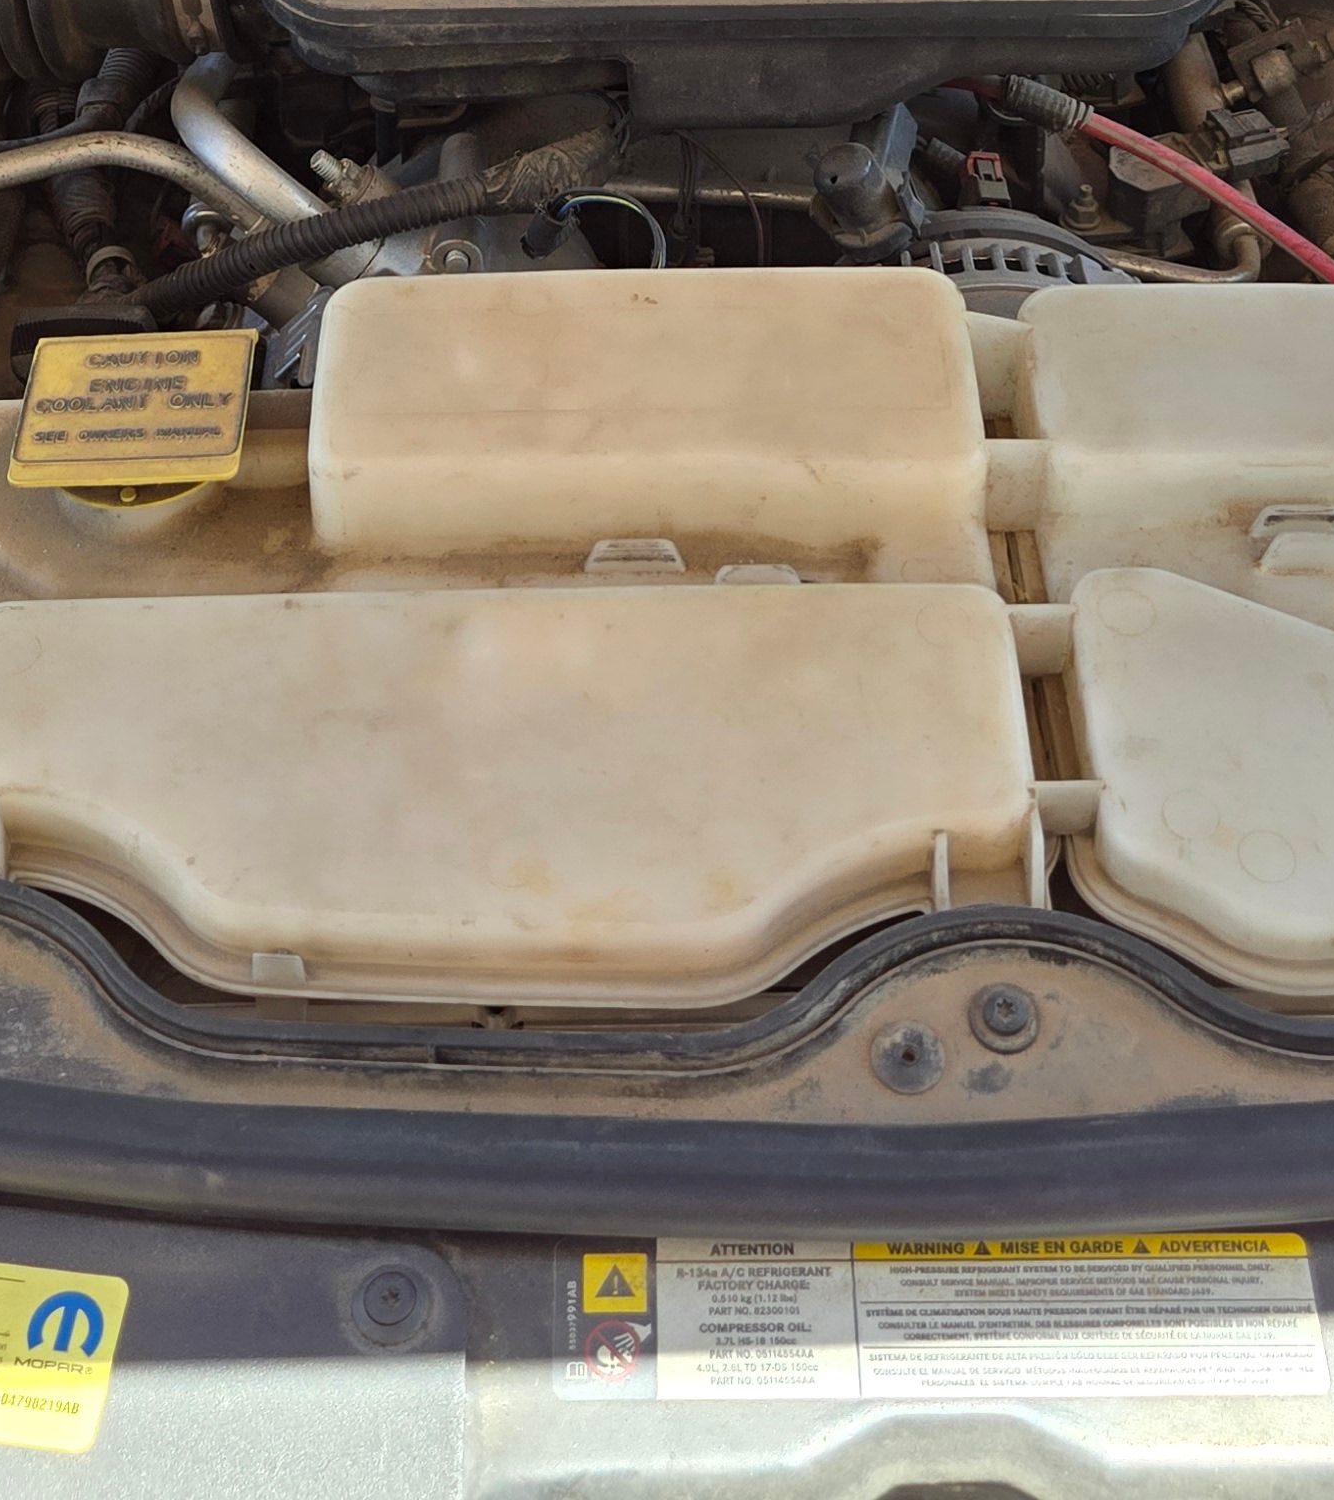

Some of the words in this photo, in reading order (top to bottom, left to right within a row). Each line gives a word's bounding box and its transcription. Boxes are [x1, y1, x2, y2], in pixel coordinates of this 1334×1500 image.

[85, 349, 201, 369] CAUTION
[88, 374, 188, 394] ENGINE
[33, 392, 150, 415] COOLANT
[169, 391, 234, 409] ONLY
[33, 429, 68, 445] SEE
[77, 427, 147, 443] OWNERS
[709, 1243, 795, 1256] ATTENTION
[887, 1242, 964, 1254] WARNING
[1001, 1242, 1039, 1253] MISE
[1045, 1242, 1064, 1253] EN
[1071, 1241, 1123, 1253] GARDE
[1160, 1240, 1270, 1252] ADVERTENCIA
[676, 1268, 718, 1278] R-134a
[720, 1267, 745, 1279] A/C
[748, 1266, 832, 1277] REFRIGERANT
[697, 1280, 753, 1290] FACTORY
[756, 1280, 810, 1290] CHARGE:
[708, 1307, 732, 1316] PART
[699, 1323, 784, 1333] COMPRESSOR
[787, 1322, 812, 1333] OIL:
[709, 1350, 734, 1359] PART
